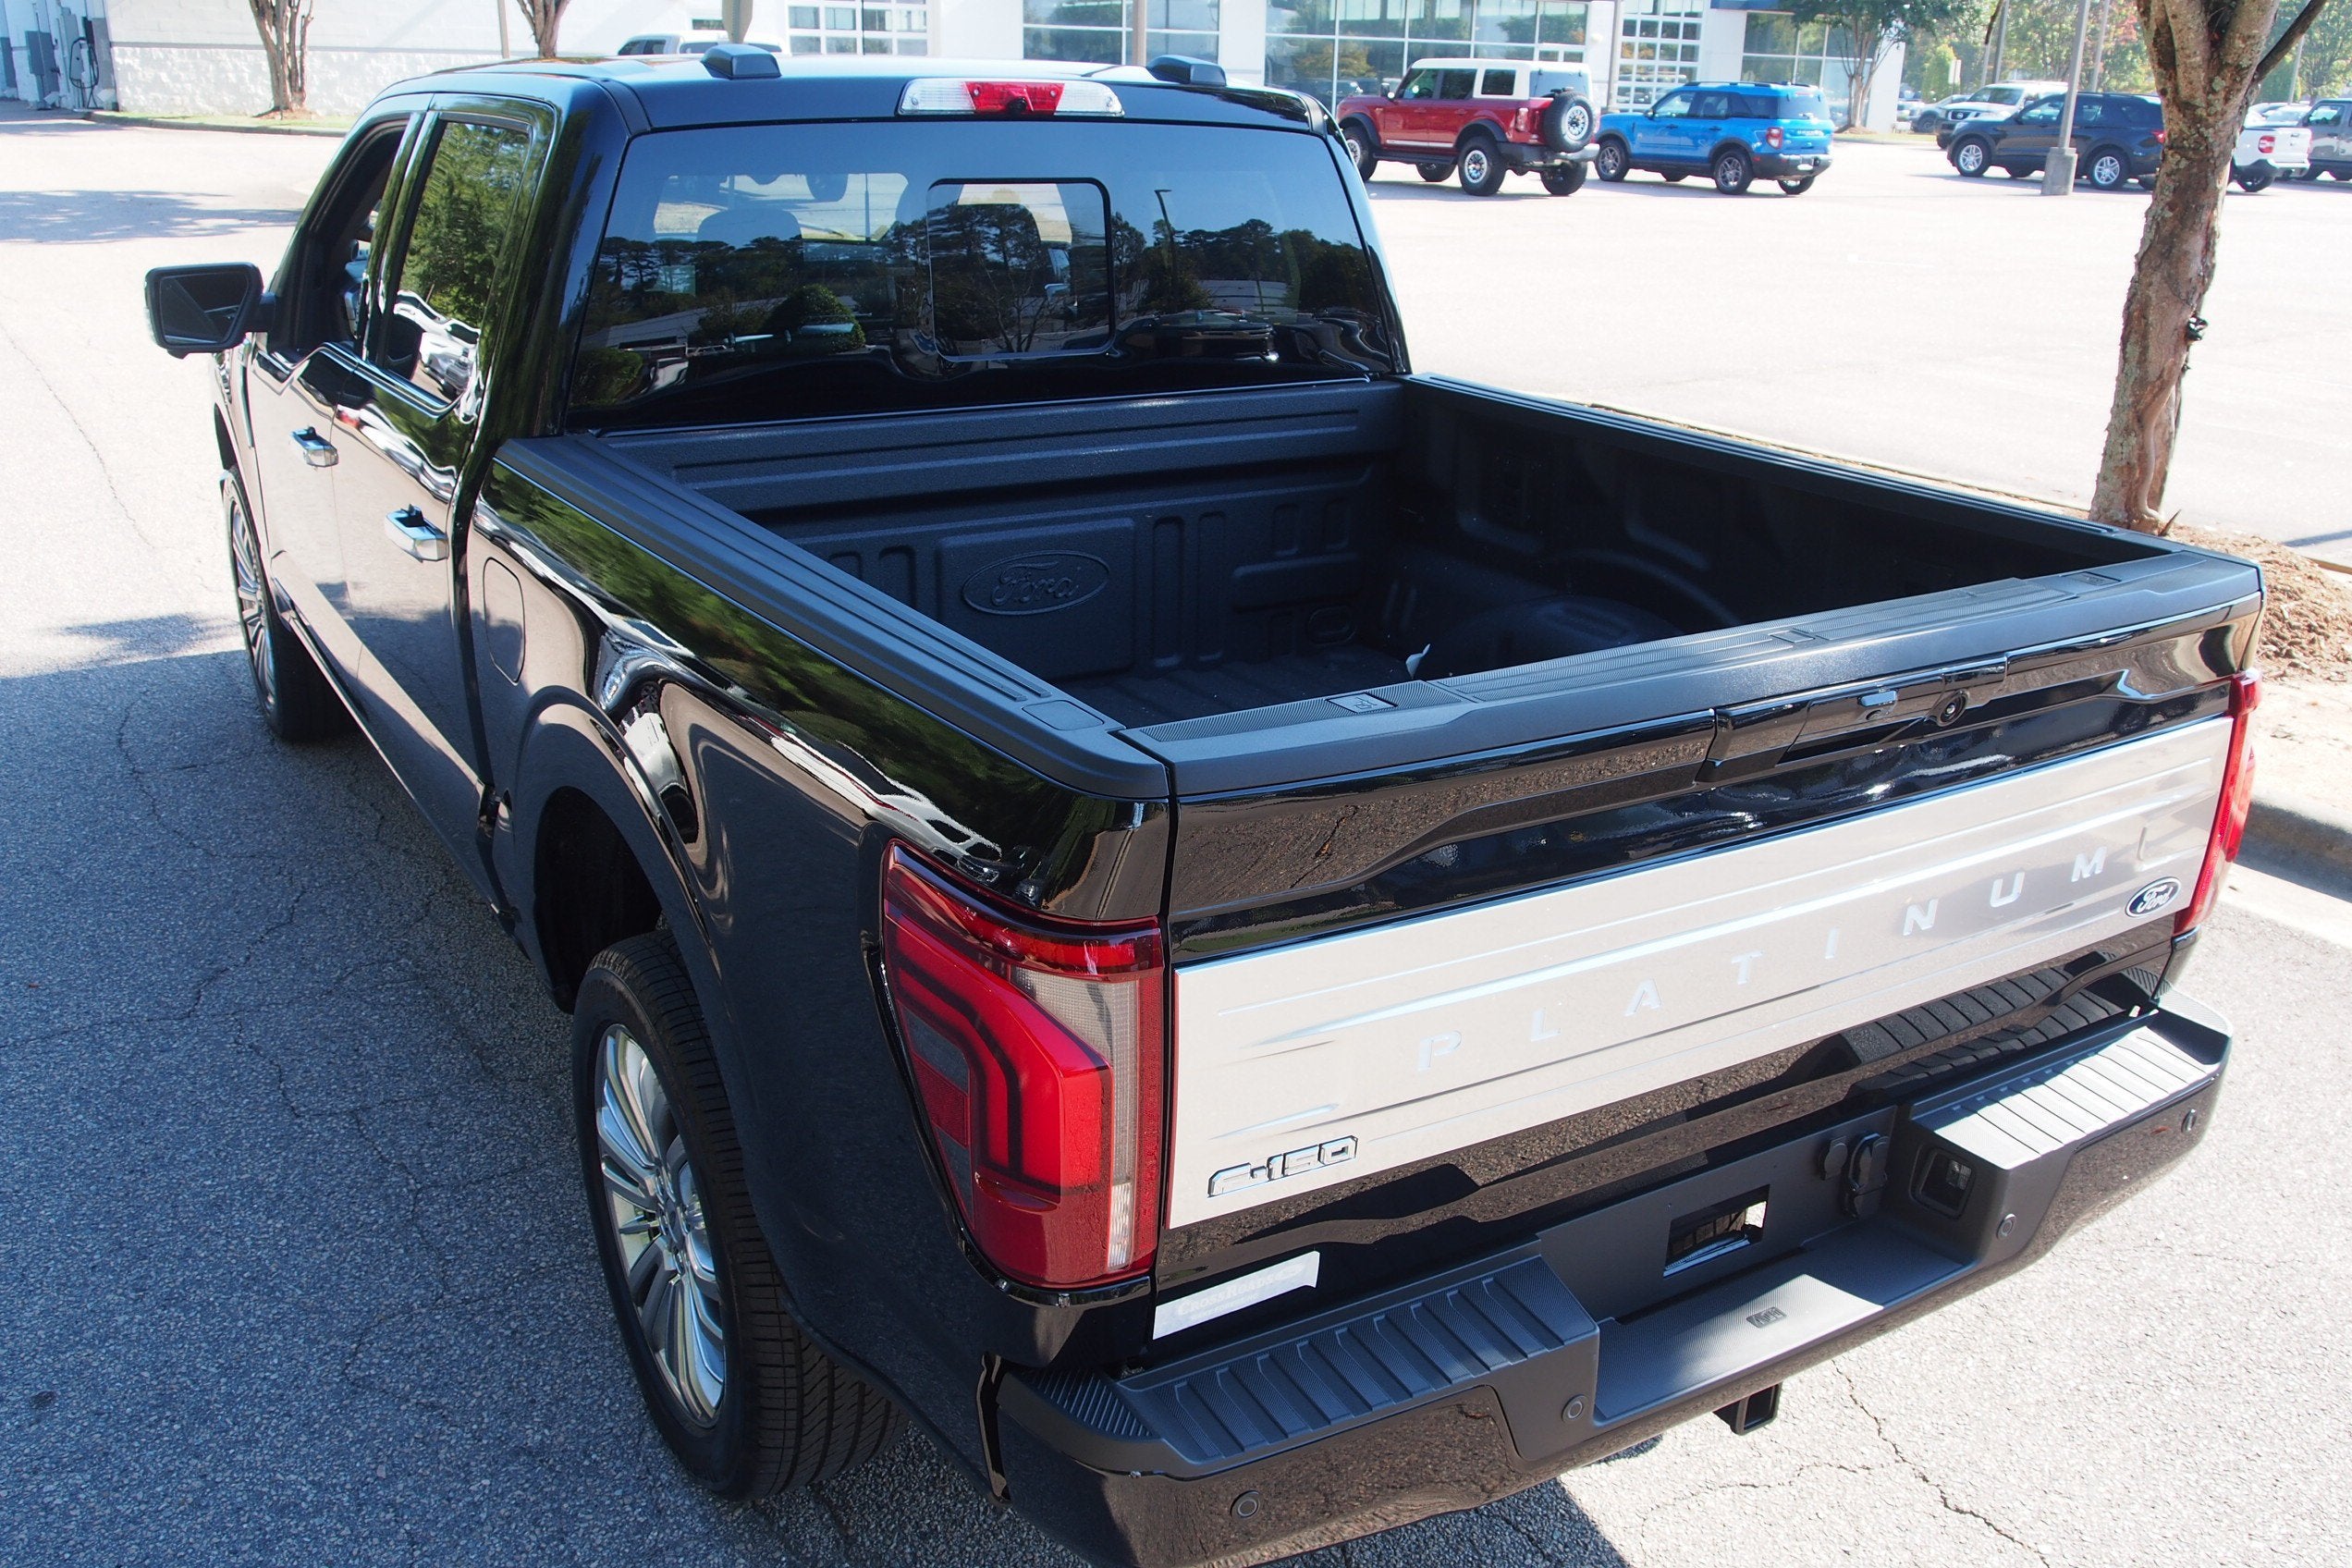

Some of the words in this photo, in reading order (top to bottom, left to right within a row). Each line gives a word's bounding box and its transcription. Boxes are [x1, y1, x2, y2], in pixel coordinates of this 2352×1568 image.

[991, 561, 1080, 606] Ford
[1417, 846, 2108, 1072] PLATINUM
[1207, 1134, 1358, 1198] F-150
